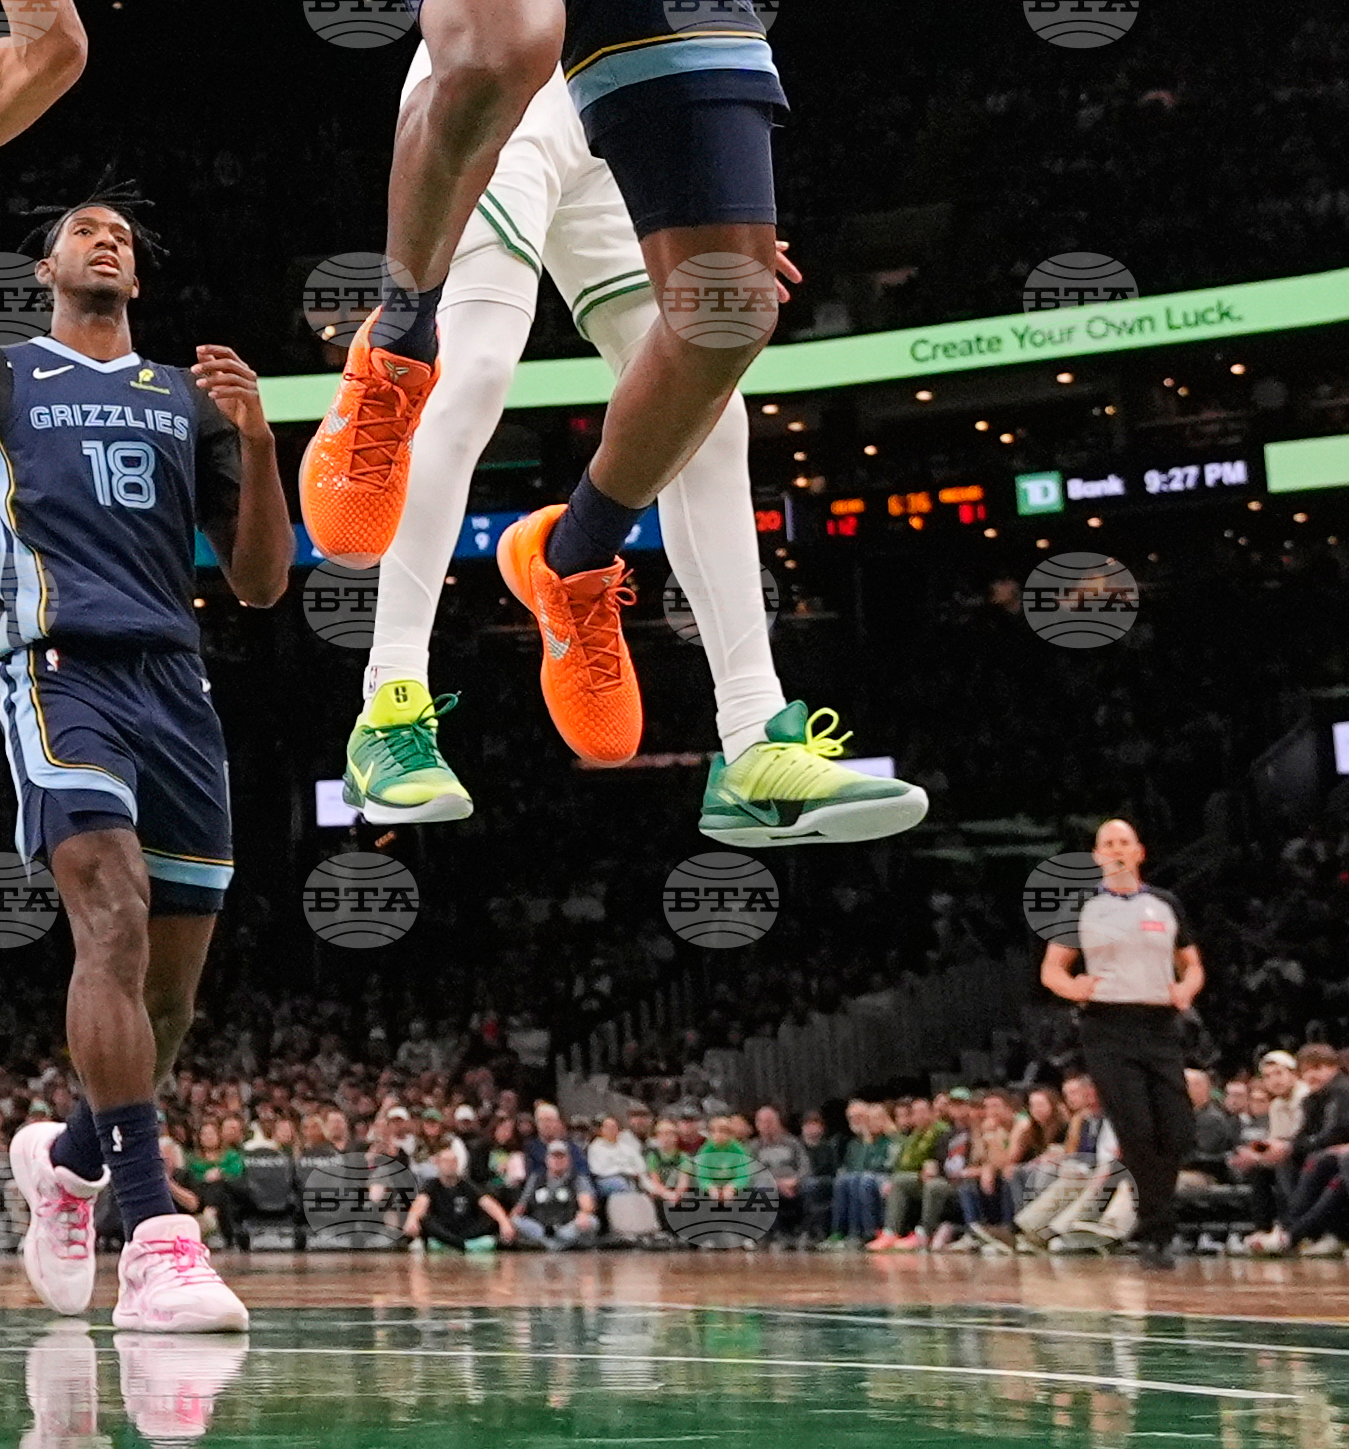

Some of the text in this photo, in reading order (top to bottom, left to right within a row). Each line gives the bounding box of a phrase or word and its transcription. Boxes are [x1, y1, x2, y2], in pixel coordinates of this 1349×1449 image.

[910, 300, 1243, 363] Create Your Own Luck.
[29, 403, 190, 441] GRIZZLIES
[81, 440, 156, 510] 18
[1022, 460, 1248, 505] TD Bank 9:27 PM
